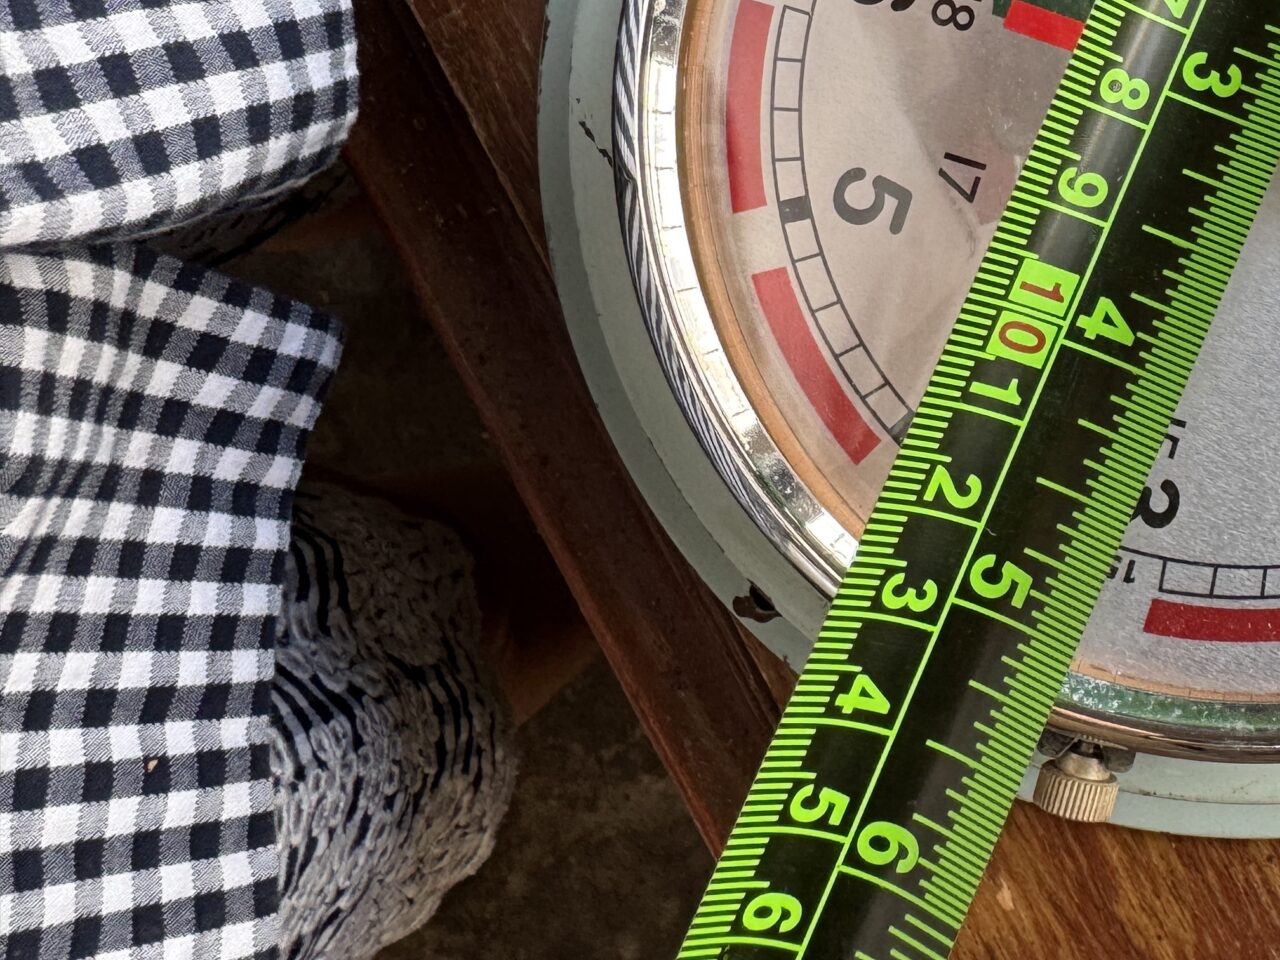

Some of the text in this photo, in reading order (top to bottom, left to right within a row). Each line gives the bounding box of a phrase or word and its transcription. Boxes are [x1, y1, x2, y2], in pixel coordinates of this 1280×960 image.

[1099, 68, 1150, 110] 8
[1183, 51, 1242, 98] 3
[938, 152, 987, 203] 17
[1058, 167, 1108, 208] 9
[833, 167, 912, 235] 5
[998, 282, 1064, 355] 10
[1076, 296, 1135, 346] 4
[969, 378, 1022, 406] 1
[923, 466, 982, 509] 2
[1130, 479, 1180, 528] 3
[881, 572, 938, 613] 3
[970, 554, 1033, 609] 5
[835, 674, 891, 714] 4
[789, 784, 850, 826] 5
[857, 820, 919, 874] 6
[742, 892, 802, 933] 6
